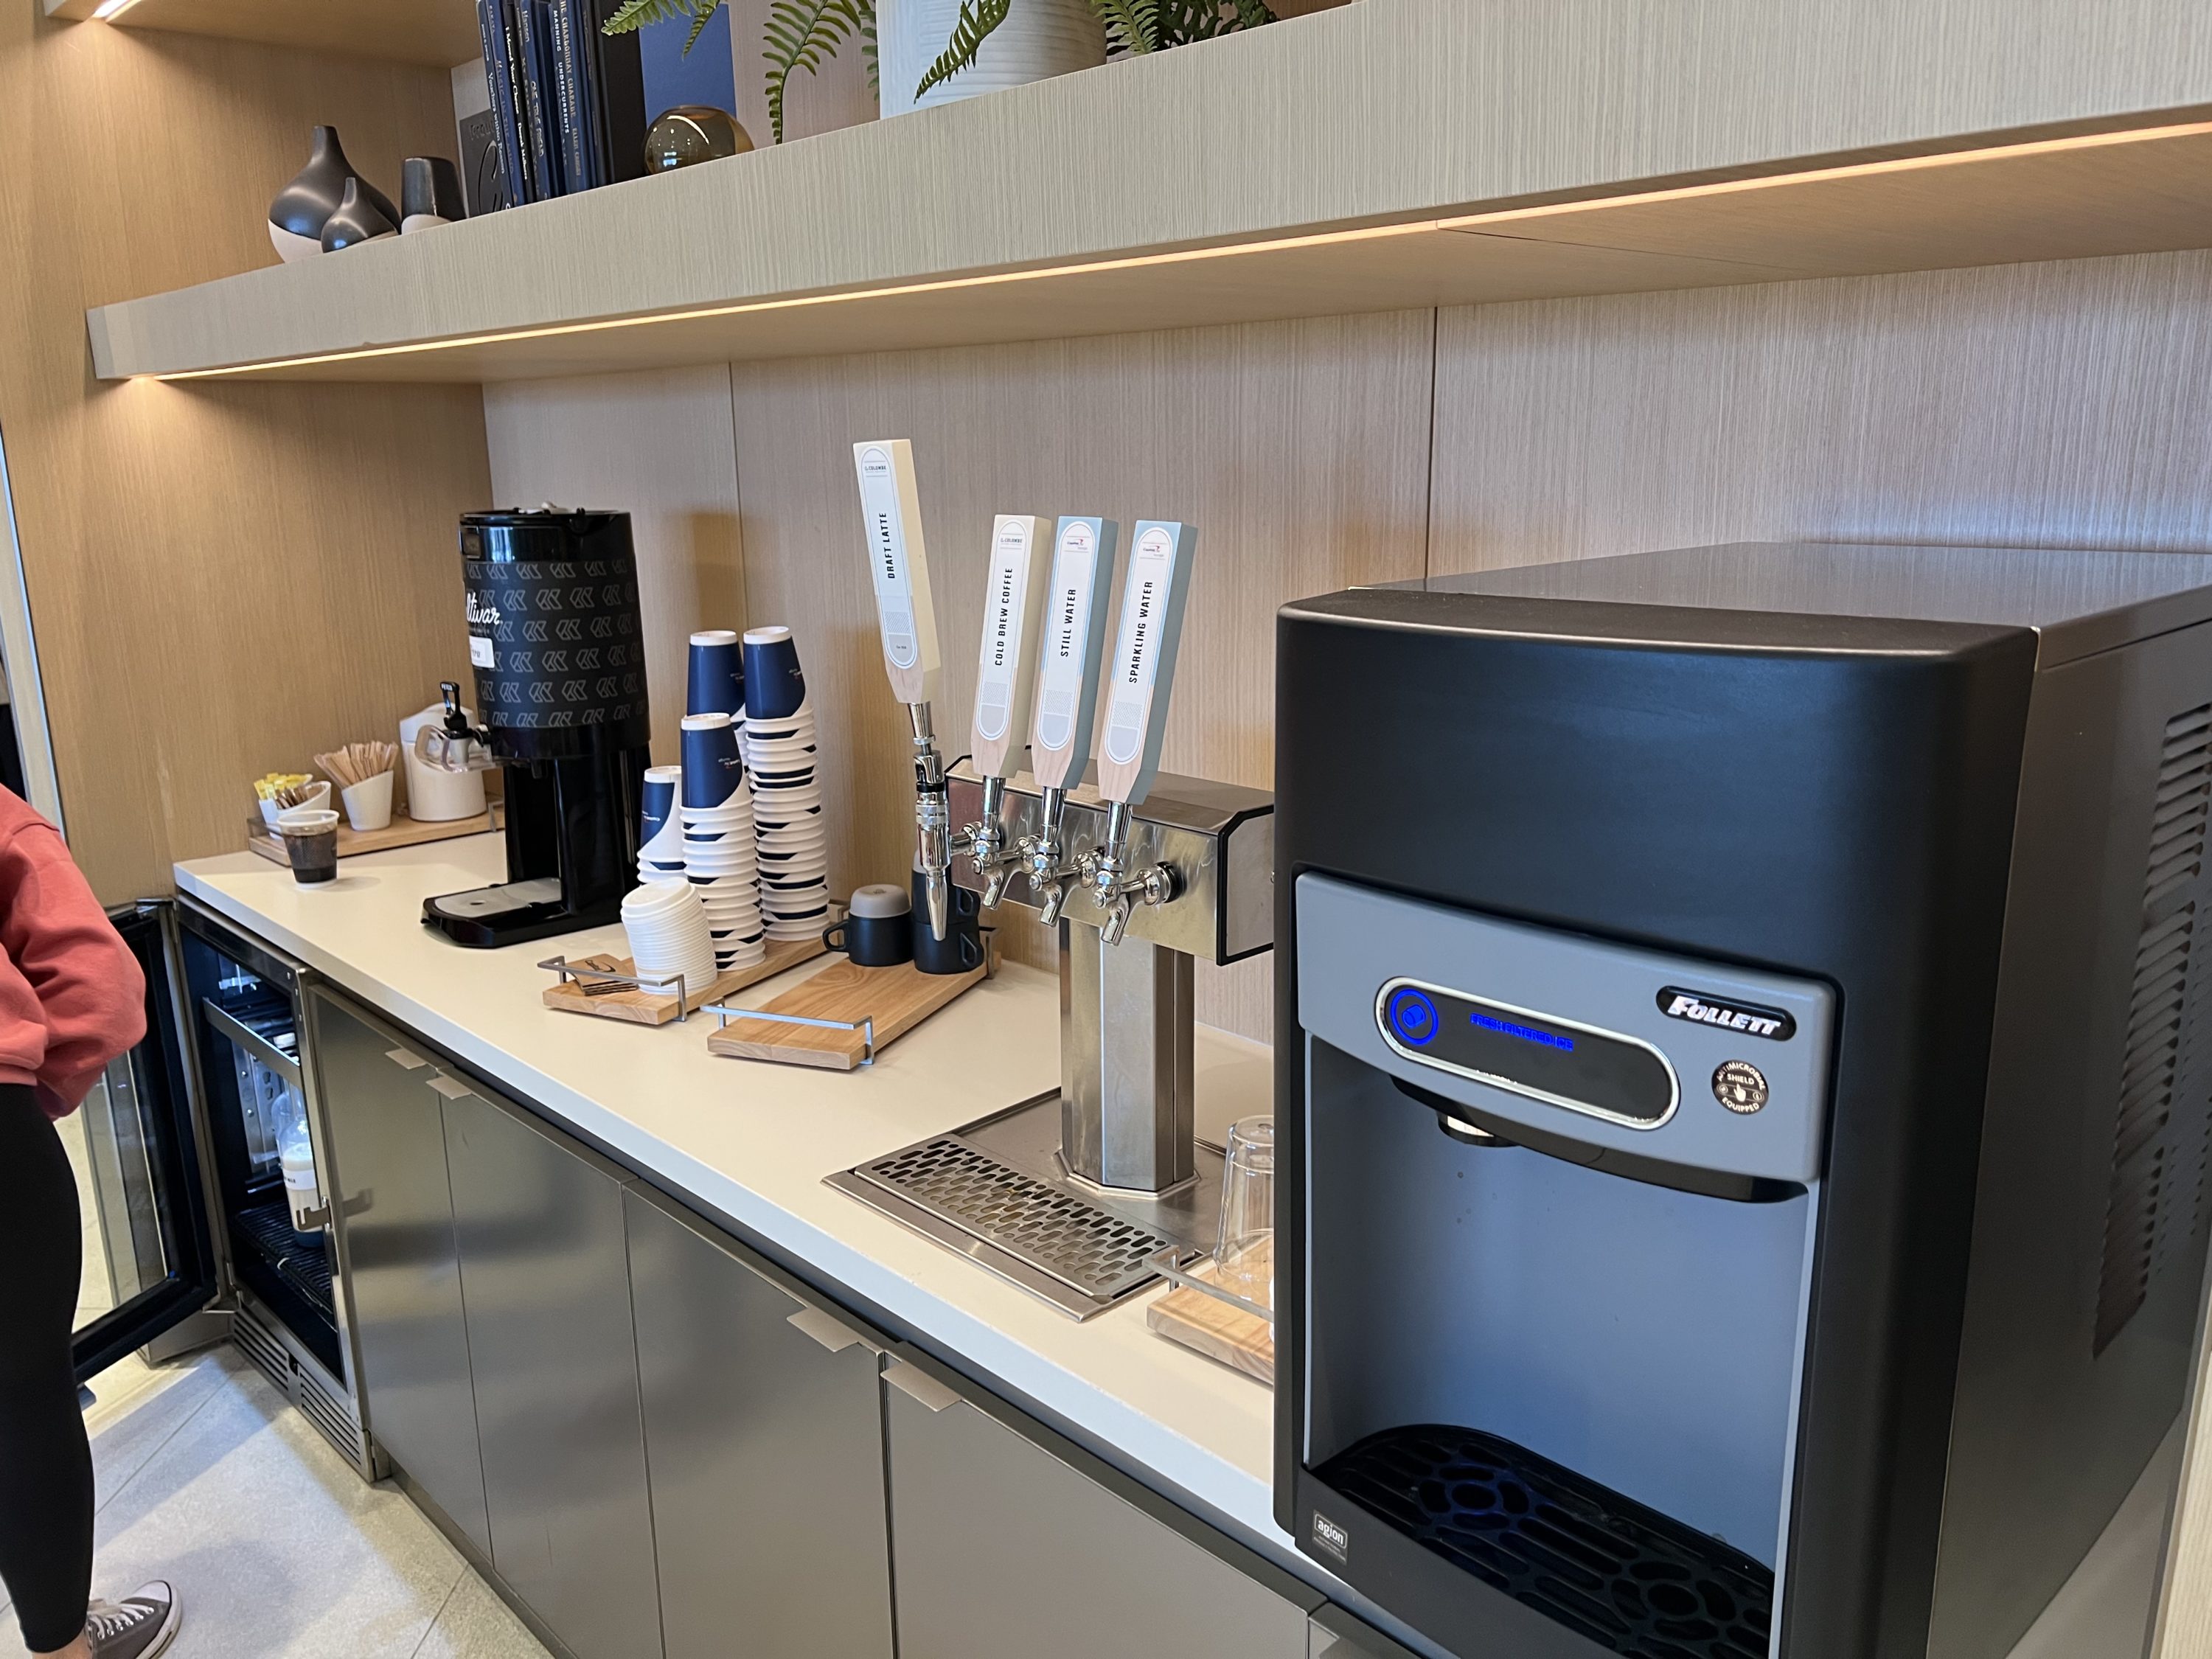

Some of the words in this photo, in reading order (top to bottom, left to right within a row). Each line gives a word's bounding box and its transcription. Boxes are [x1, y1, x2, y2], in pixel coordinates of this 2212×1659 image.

[559, 0, 568, 13] HE
[521, 10, 530, 43] Hansen
[553, 10, 562, 52] MANNING
[506, 33, 514, 61] Moved
[562, 17, 572, 74] CHARDONNAY
[530, 80, 539, 100] ONE
[557, 62, 570, 134] UNDERCURRENTS
[567, 77, 577, 118] CHARADE
[487, 72, 496, 112] Vouchers
[497, 142, 505, 175] Reason
[532, 103, 541, 125] TRUE
[536, 128, 544, 157] FRIEND
[879, 512, 891, 543] LATTE
[883, 546, 895, 579] DRAFT
[1001, 568, 1013, 604] COFFEE
[466, 591, 500, 625] ltivar
[998, 608, 1009, 636] BREW
[1064, 589, 1077, 624] WATER
[1060, 629, 1071, 657] STILL
[1129, 622, 1146, 684] SPARKLING
[1139, 581, 1153, 618] WATER
[995, 641, 1004, 666] COLD
[1667, 995, 1781, 1035] FOLLETT
[1470, 1012, 1503, 1032] FRESH
[1504, 1022, 1553, 1046] FILTERED
[1554, 1035, 1574, 1052] ICE
[1717, 1061, 1766, 1091] ANTIMICROBIAL
[1727, 1073, 1755, 1085] SHIELD
[1722, 1096, 1760, 1113] EQUIPPED
[1318, 1520, 1343, 1545] agion
